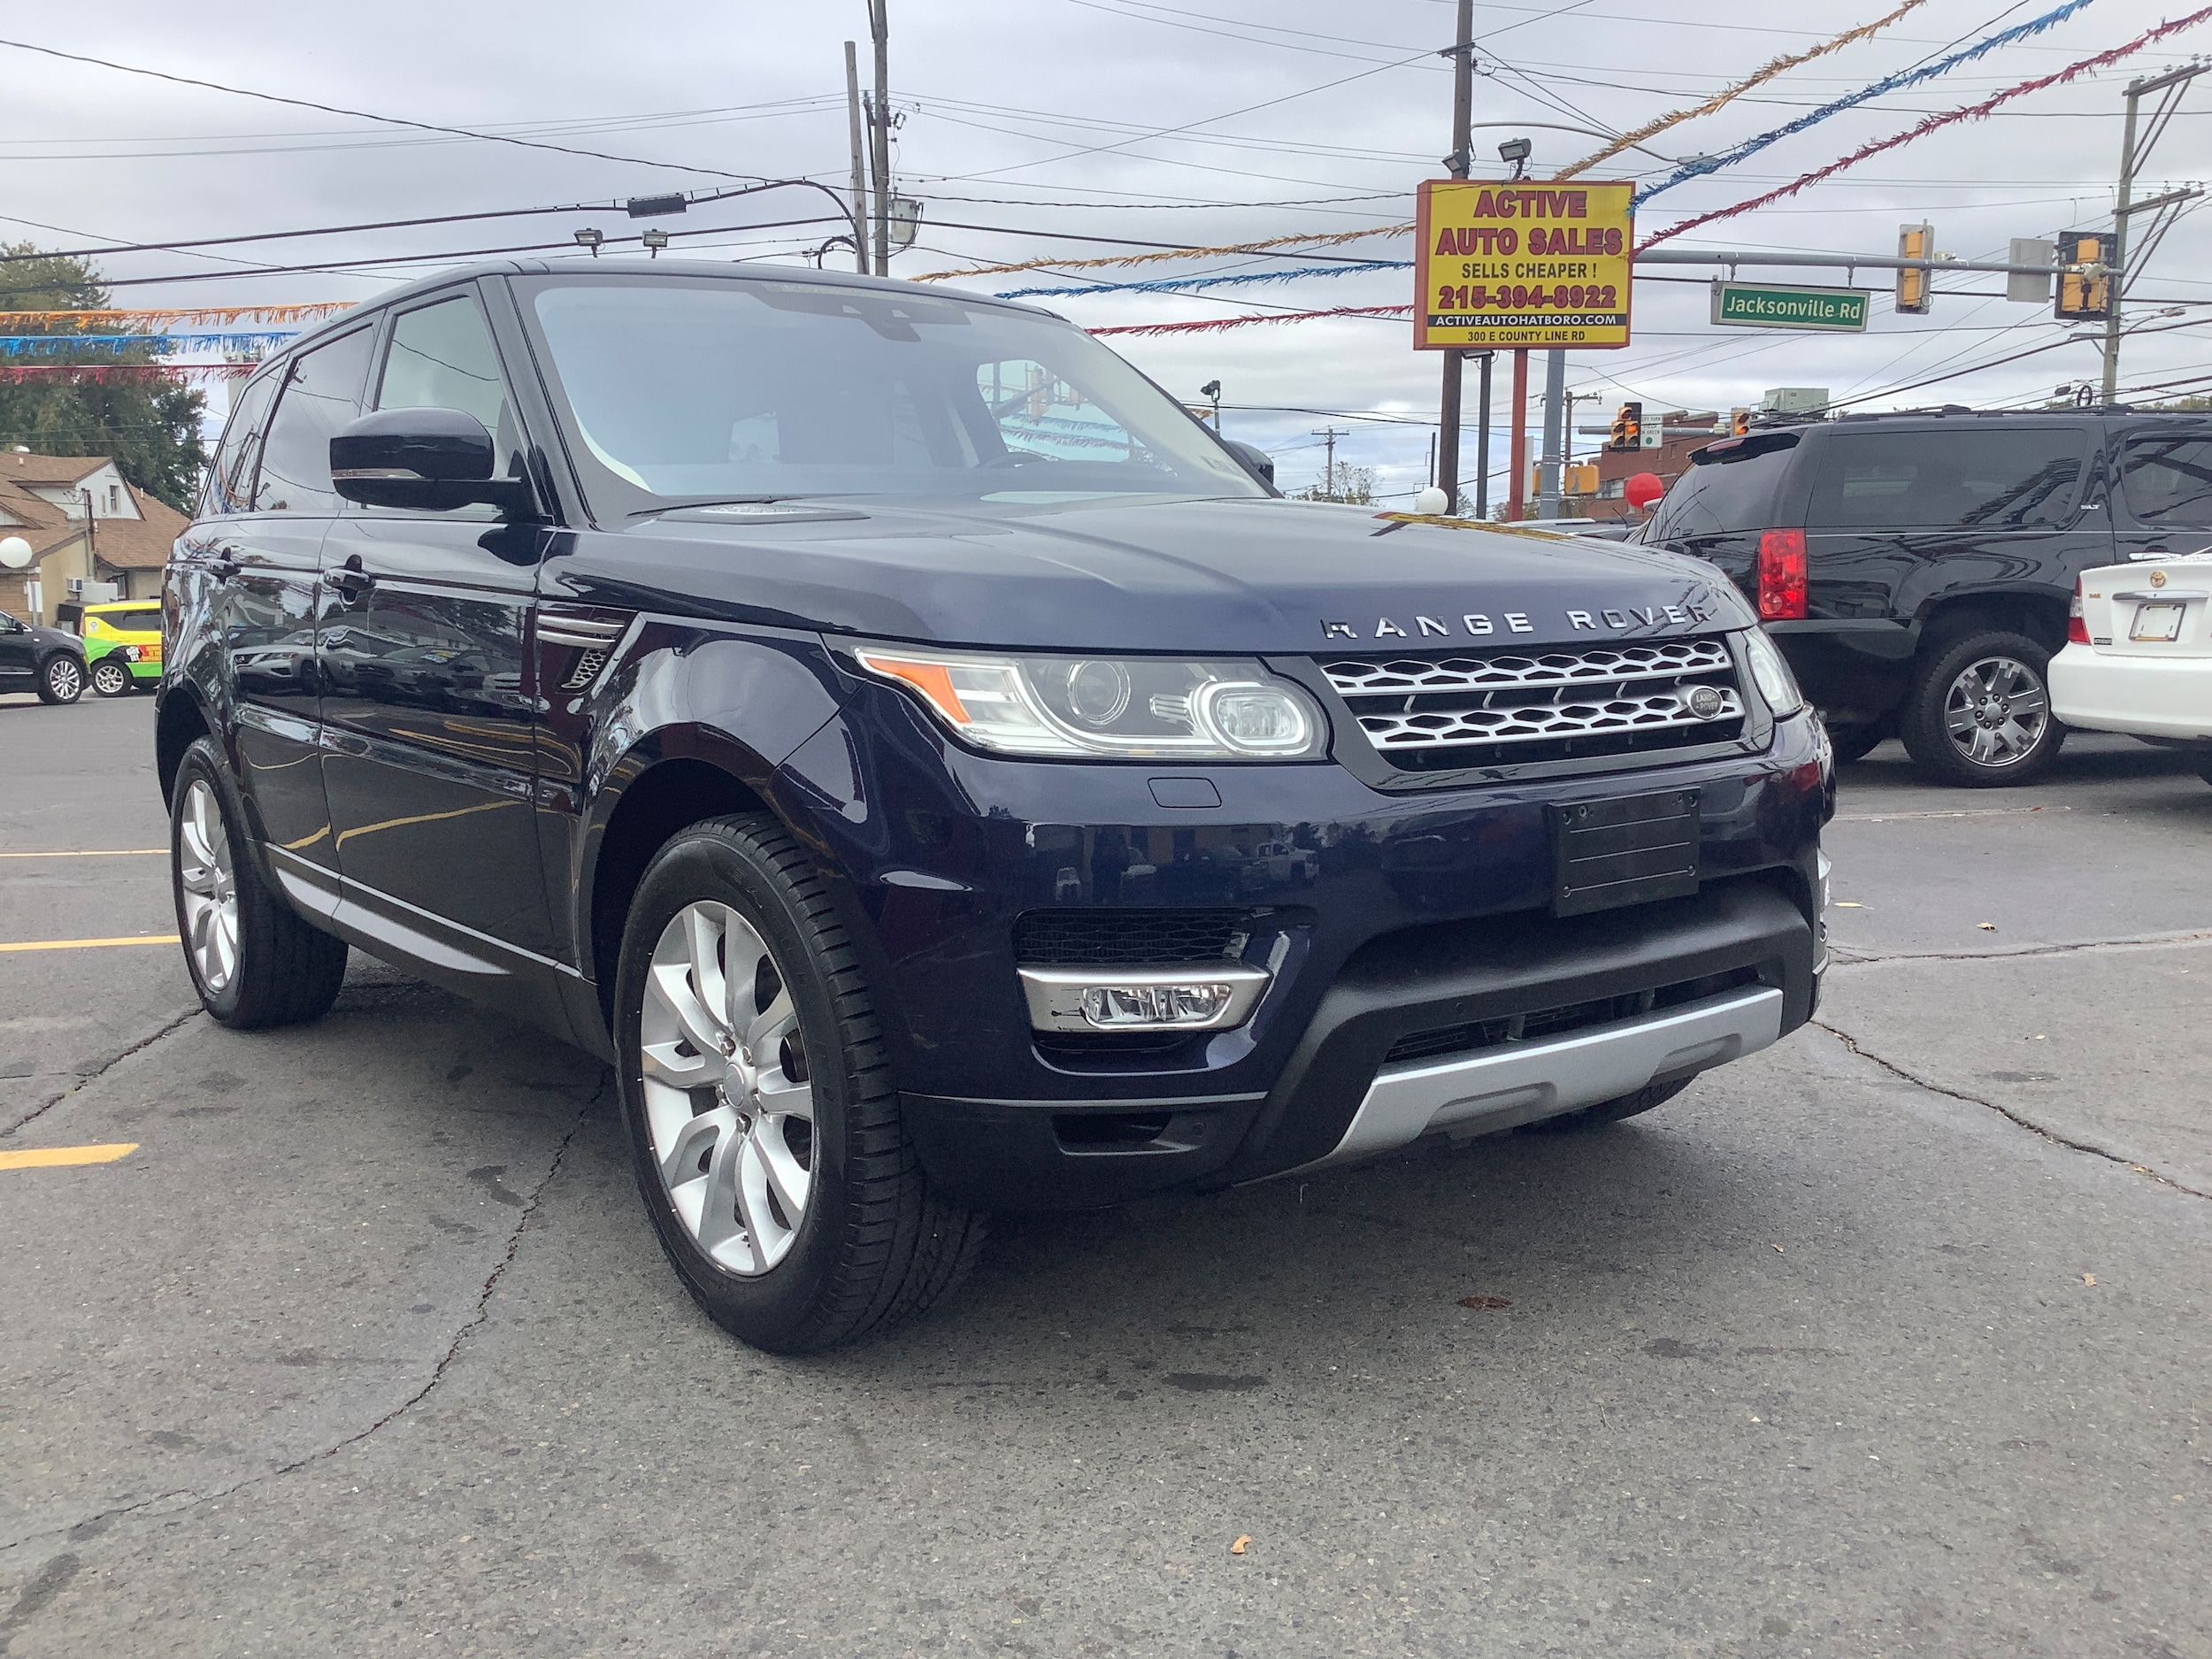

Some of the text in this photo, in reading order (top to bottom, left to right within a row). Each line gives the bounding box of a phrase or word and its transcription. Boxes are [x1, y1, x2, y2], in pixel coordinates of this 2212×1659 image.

[1473, 189, 1587, 219] ACTIVE
[1435, 227, 1518, 256] AUTO
[1528, 227, 1623, 256] SALES
[1462, 263, 1597, 279] SELLS CHEAPER !
[1438, 285, 1617, 310] 215-394-8922
[1726, 296, 1860, 319] Jacksonville Rd
[1435, 315, 1617, 326] ACTIVEAUTOHATBORO.COM
[1468, 331, 1586, 342] 300 E COUNTY LINE RD
[1320, 604, 1712, 639] RANGE ROVER
